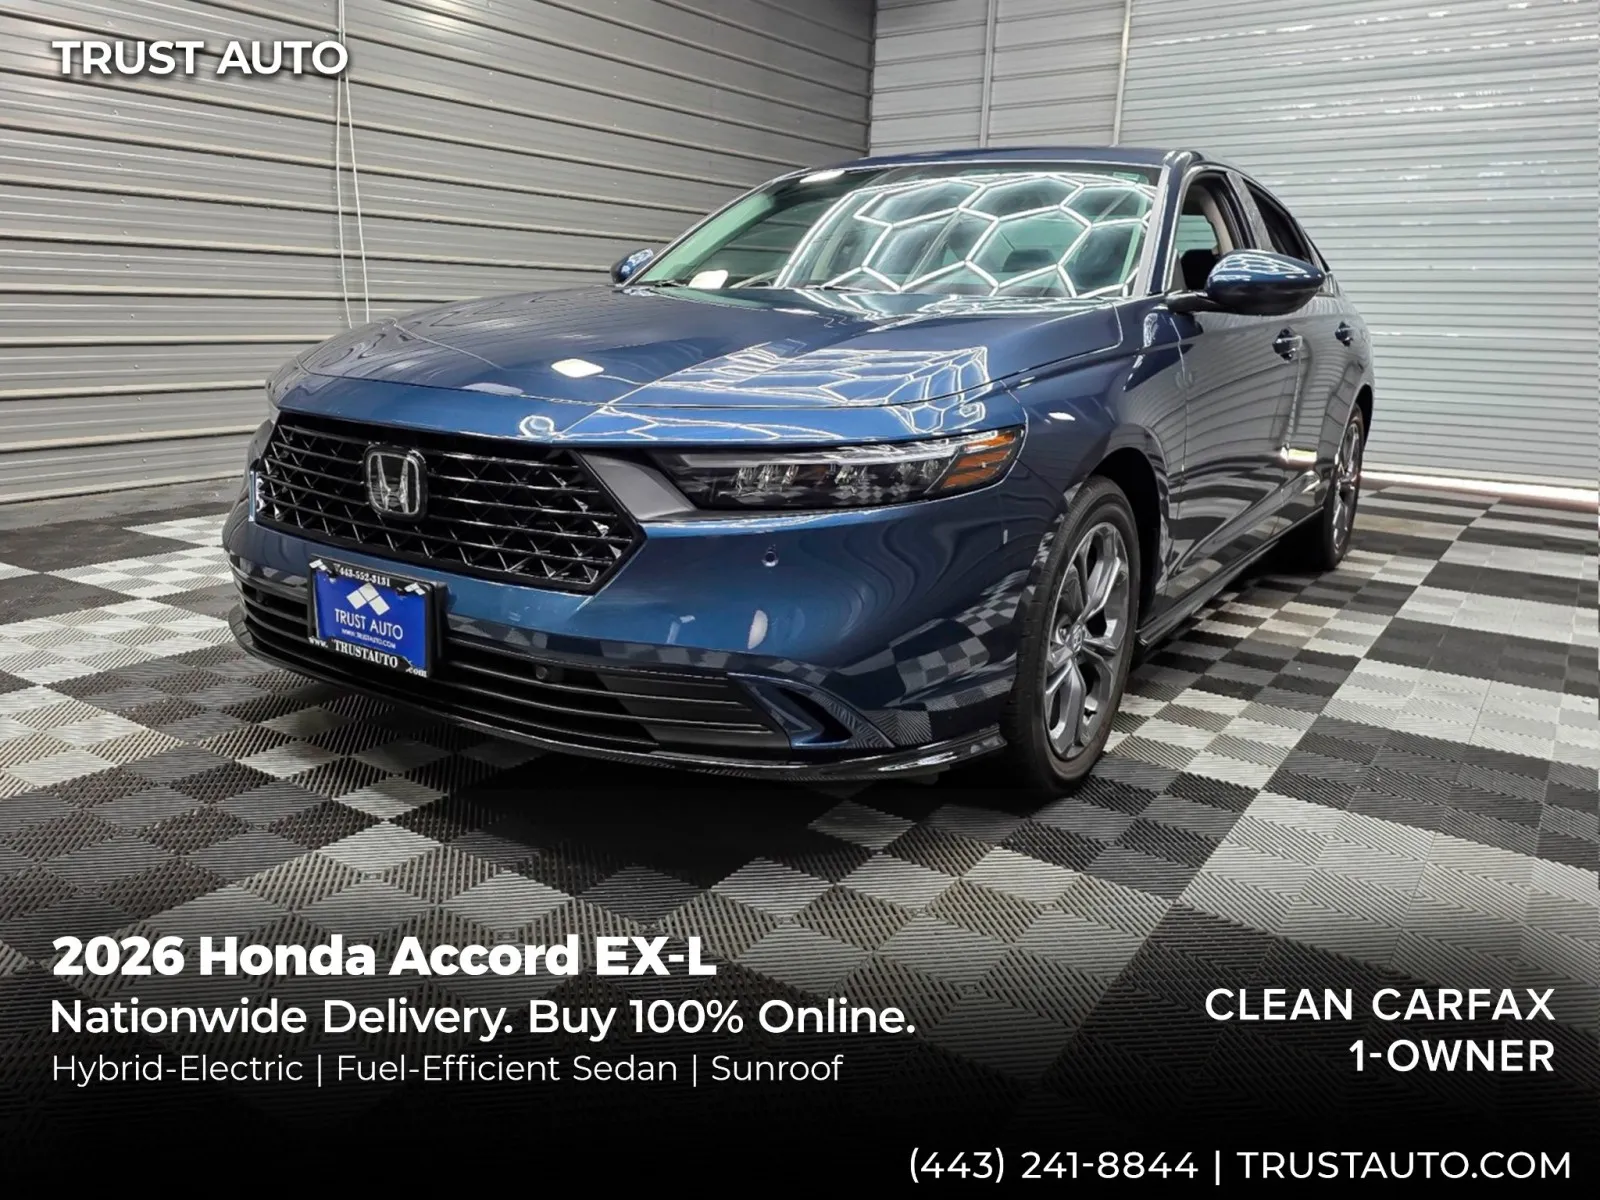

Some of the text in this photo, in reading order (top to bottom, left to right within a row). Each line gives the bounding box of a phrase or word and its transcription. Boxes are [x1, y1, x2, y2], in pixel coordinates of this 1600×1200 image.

[334, 607, 404, 640] TRUST AUTO
[333, 640, 399, 669] TRUSTAUTO
